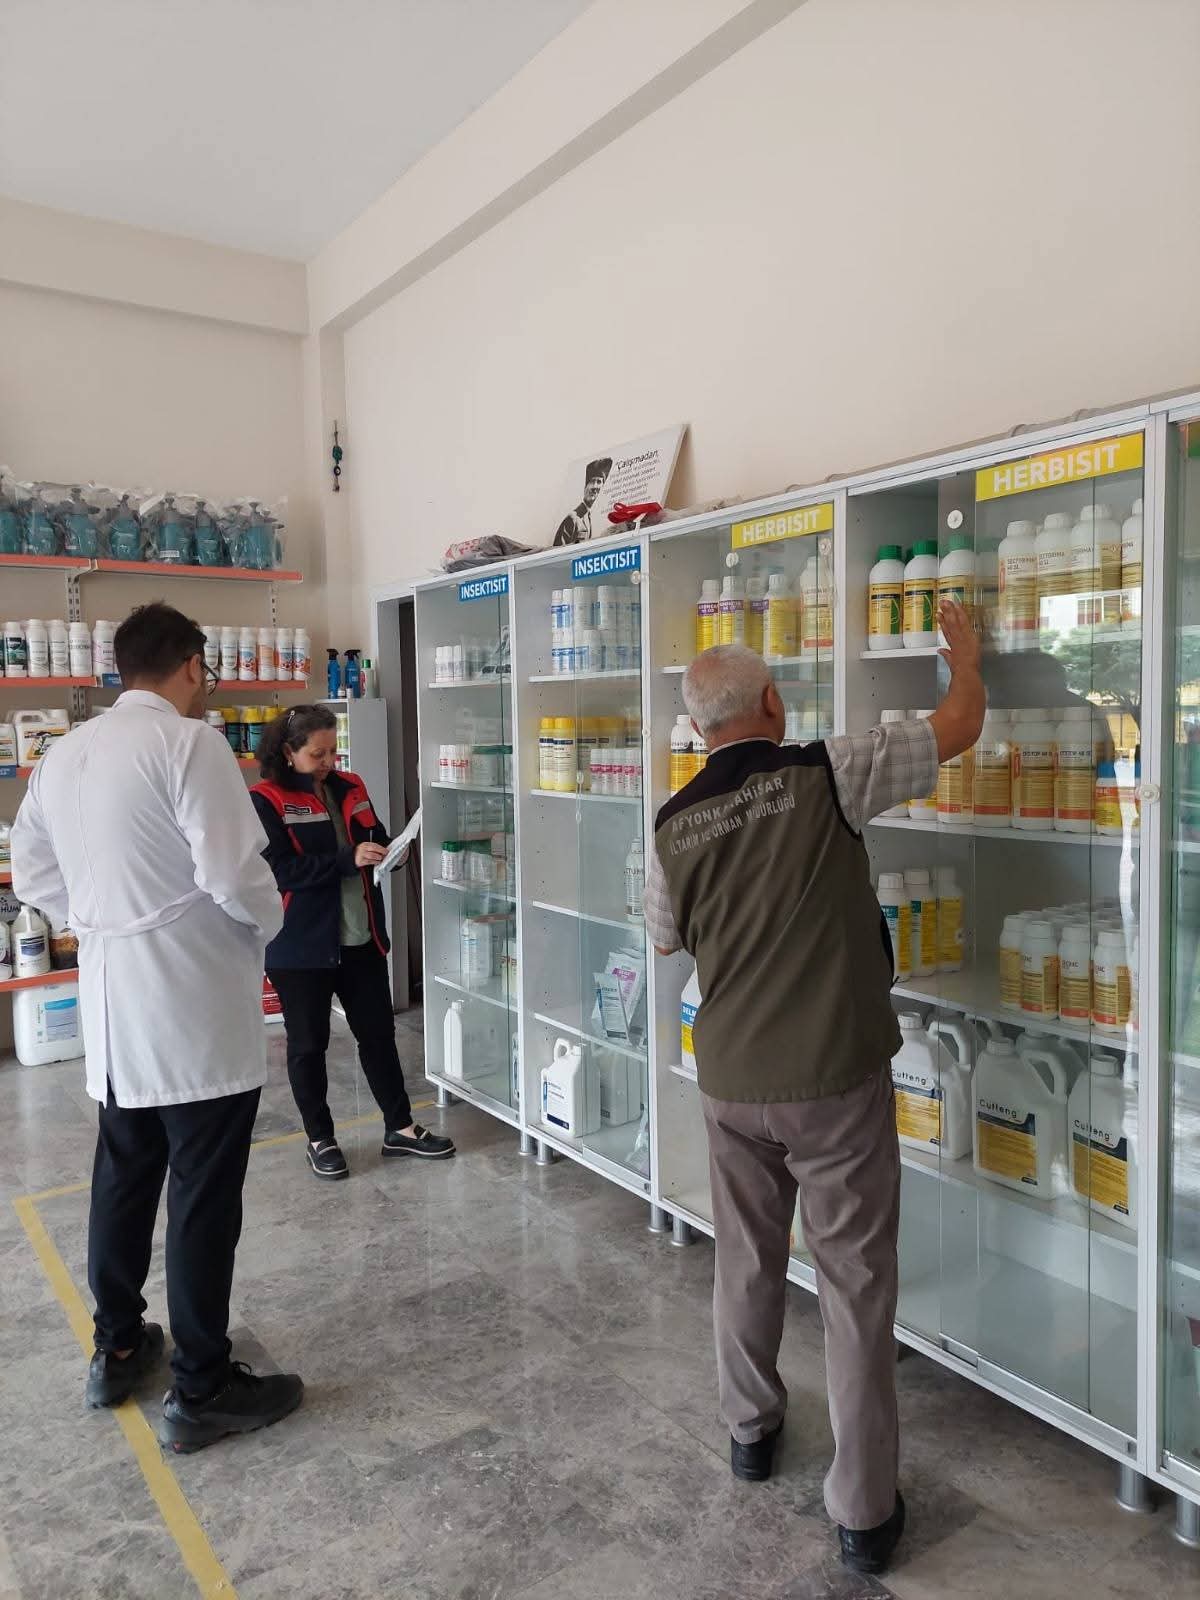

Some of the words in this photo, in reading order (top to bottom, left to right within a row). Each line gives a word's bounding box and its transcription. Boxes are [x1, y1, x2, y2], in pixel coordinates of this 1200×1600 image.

[993, 443, 1121, 493] HERBISIT
[742, 509, 821, 543] HERBISIT
[575, 549, 638, 577] INSEKTISIT
[461, 577, 507, 600] INSEKTISIT
[711, 815, 743, 839] ORMAN
